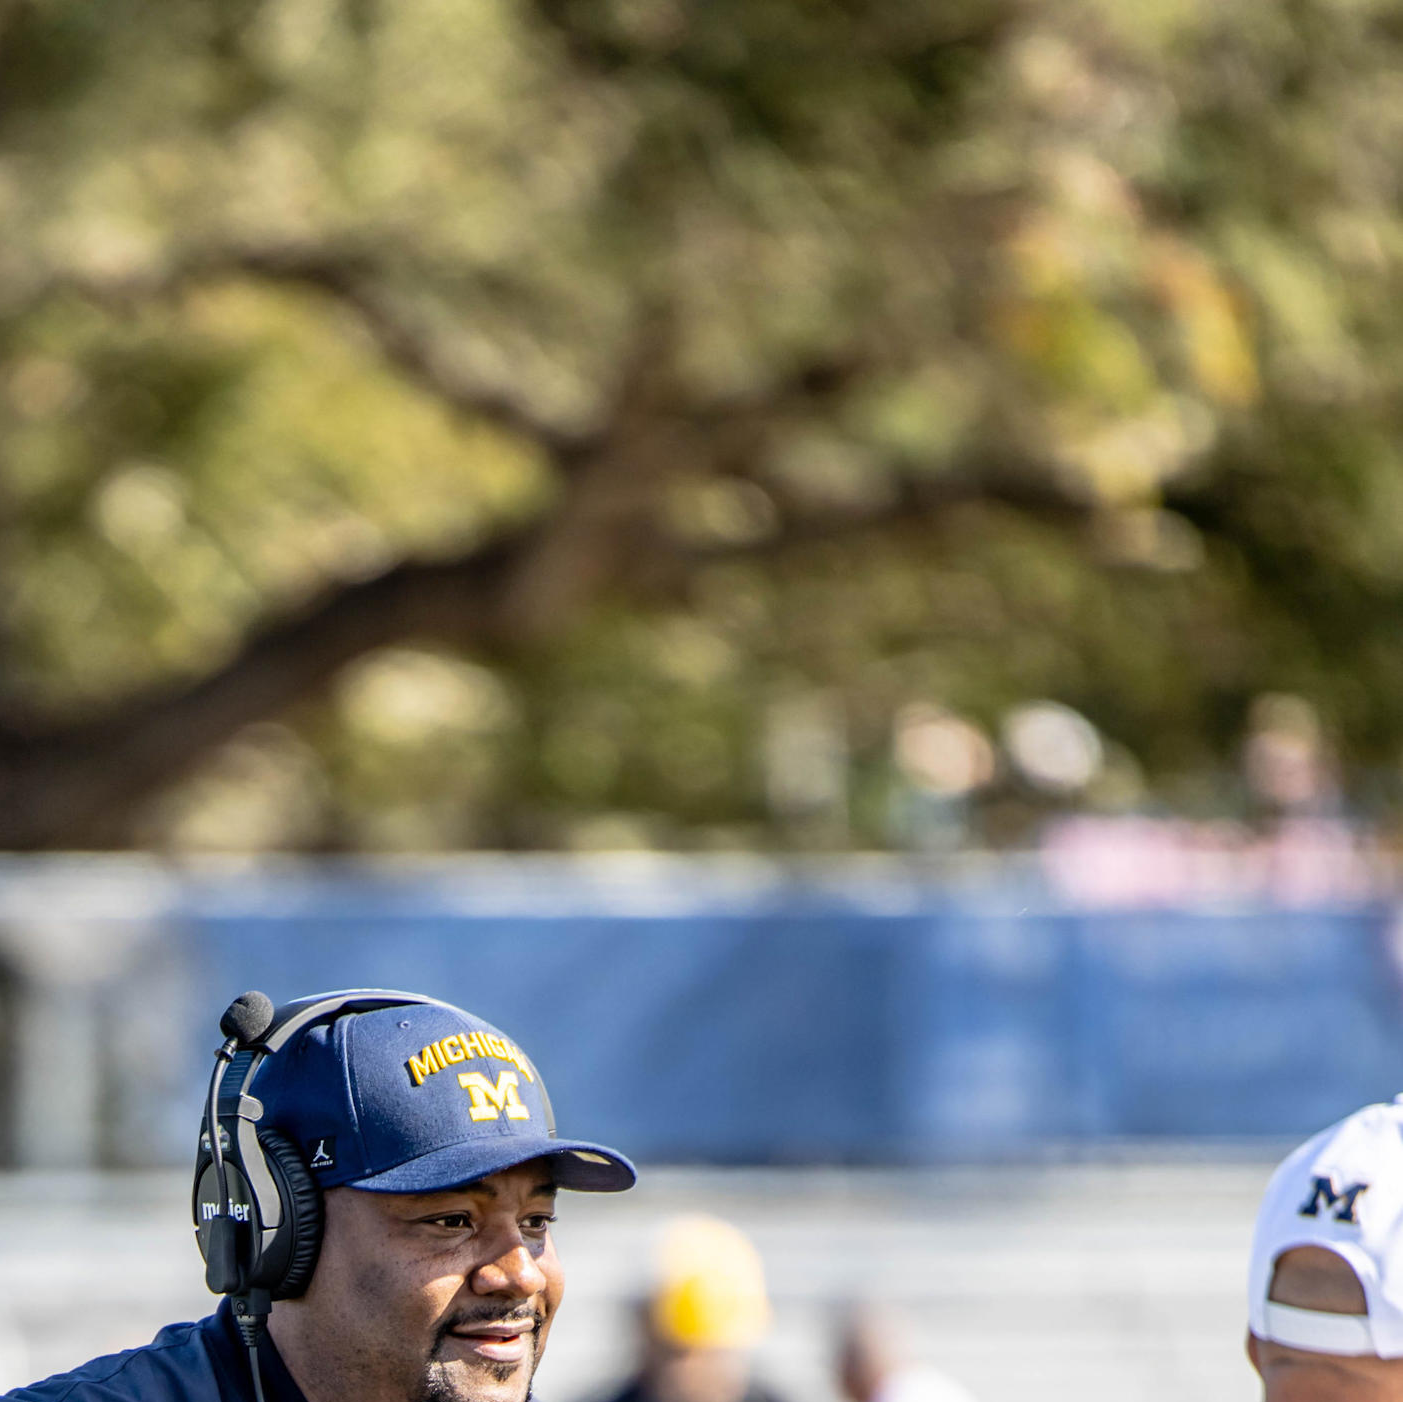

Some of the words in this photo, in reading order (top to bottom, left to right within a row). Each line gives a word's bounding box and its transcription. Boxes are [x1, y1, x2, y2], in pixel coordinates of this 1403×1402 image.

[407, 1030, 535, 1086] MICHIGAN
[457, 1070, 530, 1122] M
[1298, 1175, 1371, 1224] M
